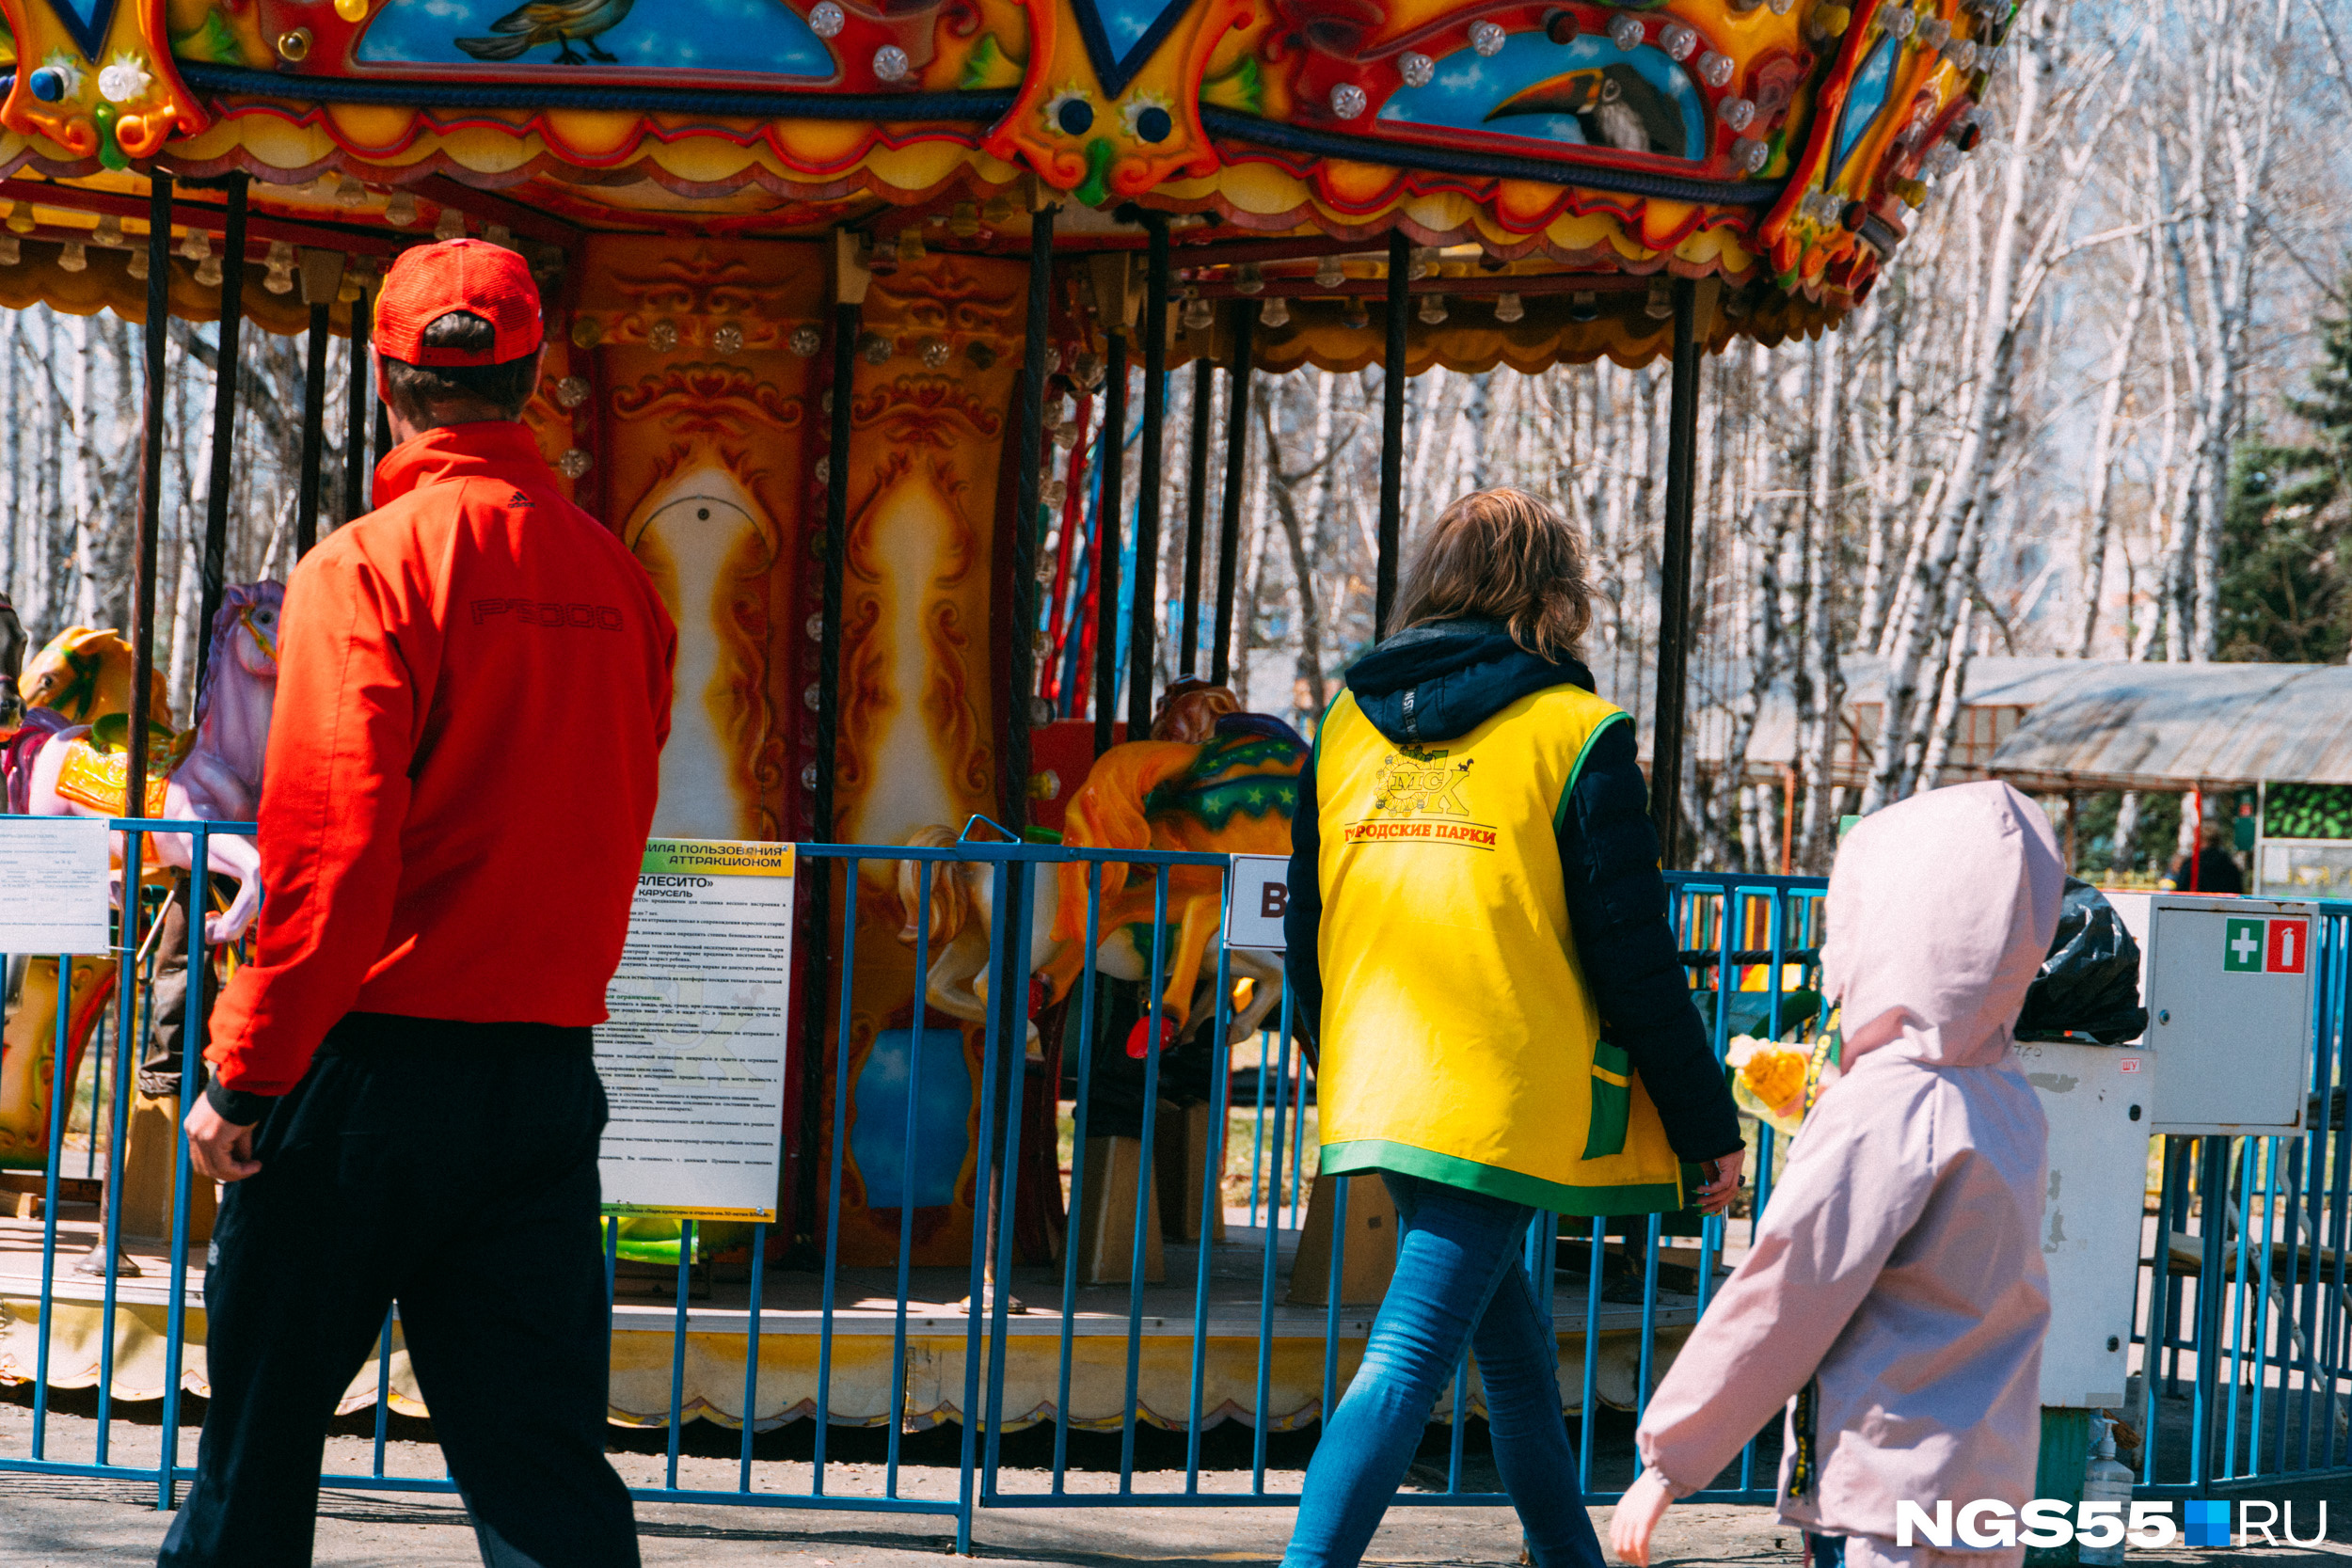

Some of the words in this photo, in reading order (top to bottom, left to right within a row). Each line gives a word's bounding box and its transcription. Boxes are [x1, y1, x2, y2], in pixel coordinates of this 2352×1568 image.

[1435, 824, 1497, 846] ПАРКИ
[679, 844, 783, 857] ПОЛЬЗОВАНИЯ
[669, 856, 782, 867] АТТРАКЦИОНОМ
[638, 876, 713, 887] АЛЕСИТО»
[639, 889, 692, 897] КАРУСЕЛЬ
[1261, 881, 1288, 919] В
[2122, 1060, 2138, 1071] ШУ
